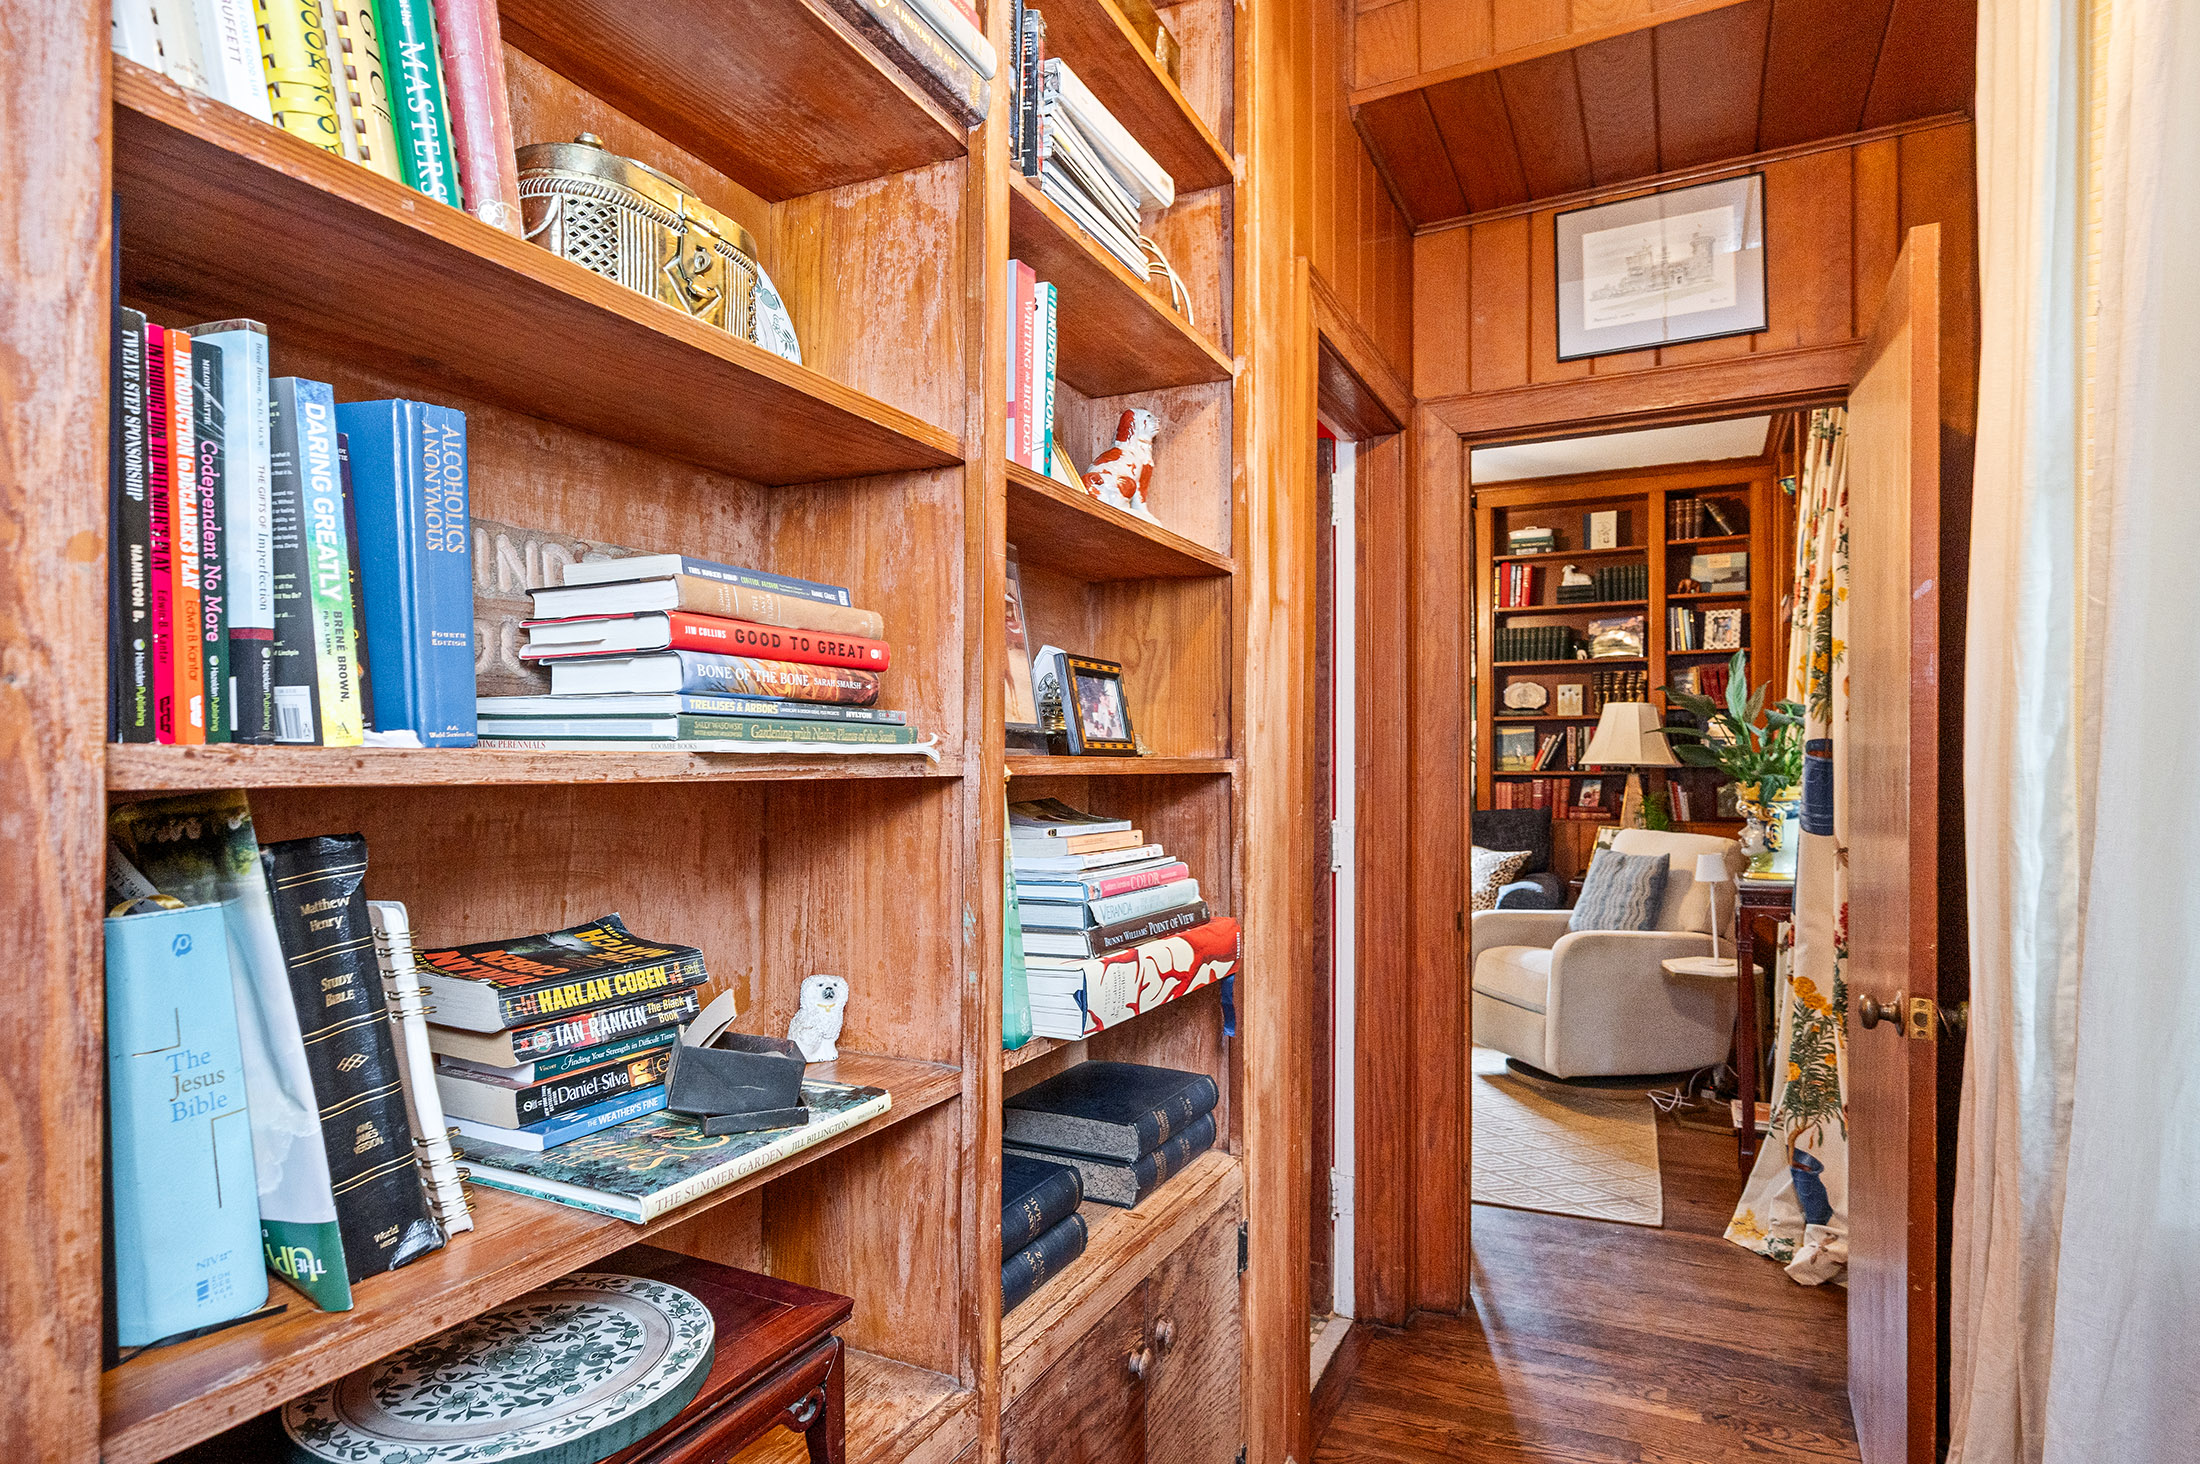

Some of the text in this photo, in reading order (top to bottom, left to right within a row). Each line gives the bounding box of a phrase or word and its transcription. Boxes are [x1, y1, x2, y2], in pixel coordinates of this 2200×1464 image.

[1024, 301, 1035, 368] WRITING
[1047, 305, 1057, 373] BRIDGE
[173, 349, 195, 456] INTRODUCTION
[1023, 386, 1032, 413] BIG
[1045, 375, 1056, 431] BOOK
[122, 330, 144, 502] TWELVE STEP SPONSORSHIP
[1022, 414, 1033, 456] BOOK
[258, 465, 266, 483] THE
[422, 420, 444, 552] ANONYMOUS
[442, 423, 465, 554] ALCOHOLICS
[257, 486, 266, 514] GIFTS
[304, 402, 342, 601] DARING GREATLY
[197, 440, 223, 642] Codependent No More
[129, 544, 145, 607] HAMILTON
[180, 555, 200, 590] PLAY
[256, 531, 272, 611] Imperfection
[185, 600, 198, 632] Edwin
[333, 611, 346, 651] BRENÉ
[684, 625, 727, 639] JIM COLLINS
[735, 629, 865, 659] GOOD TO GREAT
[158, 633, 170, 664] Kantar
[186, 645, 200, 682] Kantar
[697, 663, 810, 687] BONE OF THE BONE
[813, 677, 862, 690] SARAH SMARSH
[689, 699, 779, 714] TRELLISES & ARBORS
[846, 710, 872, 719] HYLTON
[498, 740, 546, 749] PERENNIALS
[677, 742, 698, 750] BOOKS
[750, 724, 793, 742] Gardening
[794, 726, 812, 740] with
[812, 727, 836, 741] Native
[878, 730, 897, 743] South
[1129, 872, 1161, 890] COLOR
[300, 896, 351, 917] Matthew
[1099, 902, 1133, 922] VERANDA
[309, 915, 344, 932] Henry
[1103, 934, 1124, 947] BUNNY
[1147, 918, 1170, 936] POINT
[1169, 916, 1180, 929] OF
[1177, 912, 1195, 928] VIEW
[424, 950, 544, 986] HARLAN
[471, 949, 570, 976] COBEN
[320, 972, 354, 992] STUDY
[537, 977, 614, 1013] HARLAN
[613, 966, 668, 996] COBEN
[325, 989, 356, 1008] BIBLE
[647, 1001, 662, 1014] The
[662, 996, 686, 1011] Black
[555, 1005, 648, 1047] IAN RANKIN
[658, 1011, 680, 1024] Book
[165, 1049, 212, 1073] The
[561, 1032, 676, 1071] Finding Your Strength in Difficult Times
[169, 1069, 226, 1102] Jesus
[558, 1072, 630, 1105] Daniel Silva
[170, 1091, 229, 1124] Bible
[587, 1097, 659, 1127] THE WEATHER'S FINE
[356, 1120, 374, 1134] KING
[356, 1128, 379, 1145] JAMES
[788, 1118, 850, 1154] JILL BILLINGTON
[353, 1136, 385, 1155] VERSION
[654, 1145, 784, 1213] THE SUMMER GARDEN
[373, 1224, 400, 1243] World
[293, 1256, 328, 1275] THE
